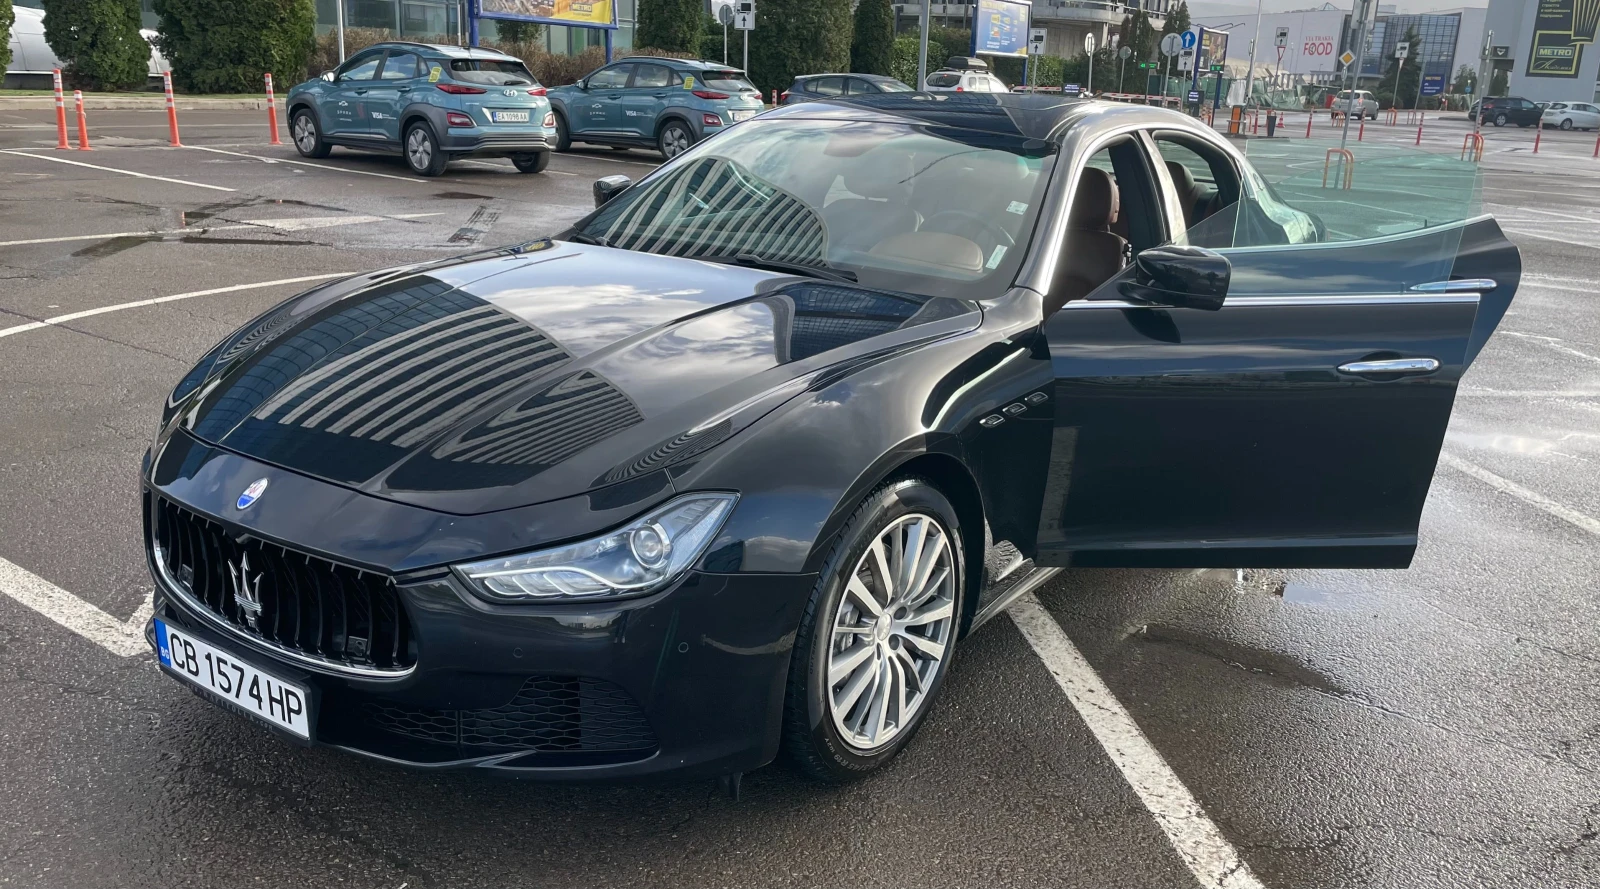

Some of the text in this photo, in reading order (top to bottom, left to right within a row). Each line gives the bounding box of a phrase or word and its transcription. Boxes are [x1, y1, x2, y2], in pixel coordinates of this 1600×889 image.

[1303, 42, 1332, 55] FOOD
[1539, 48, 1572, 56] METRO
[161, 646, 170, 659] BG
[170, 633, 302, 725] CB 1574 HP
